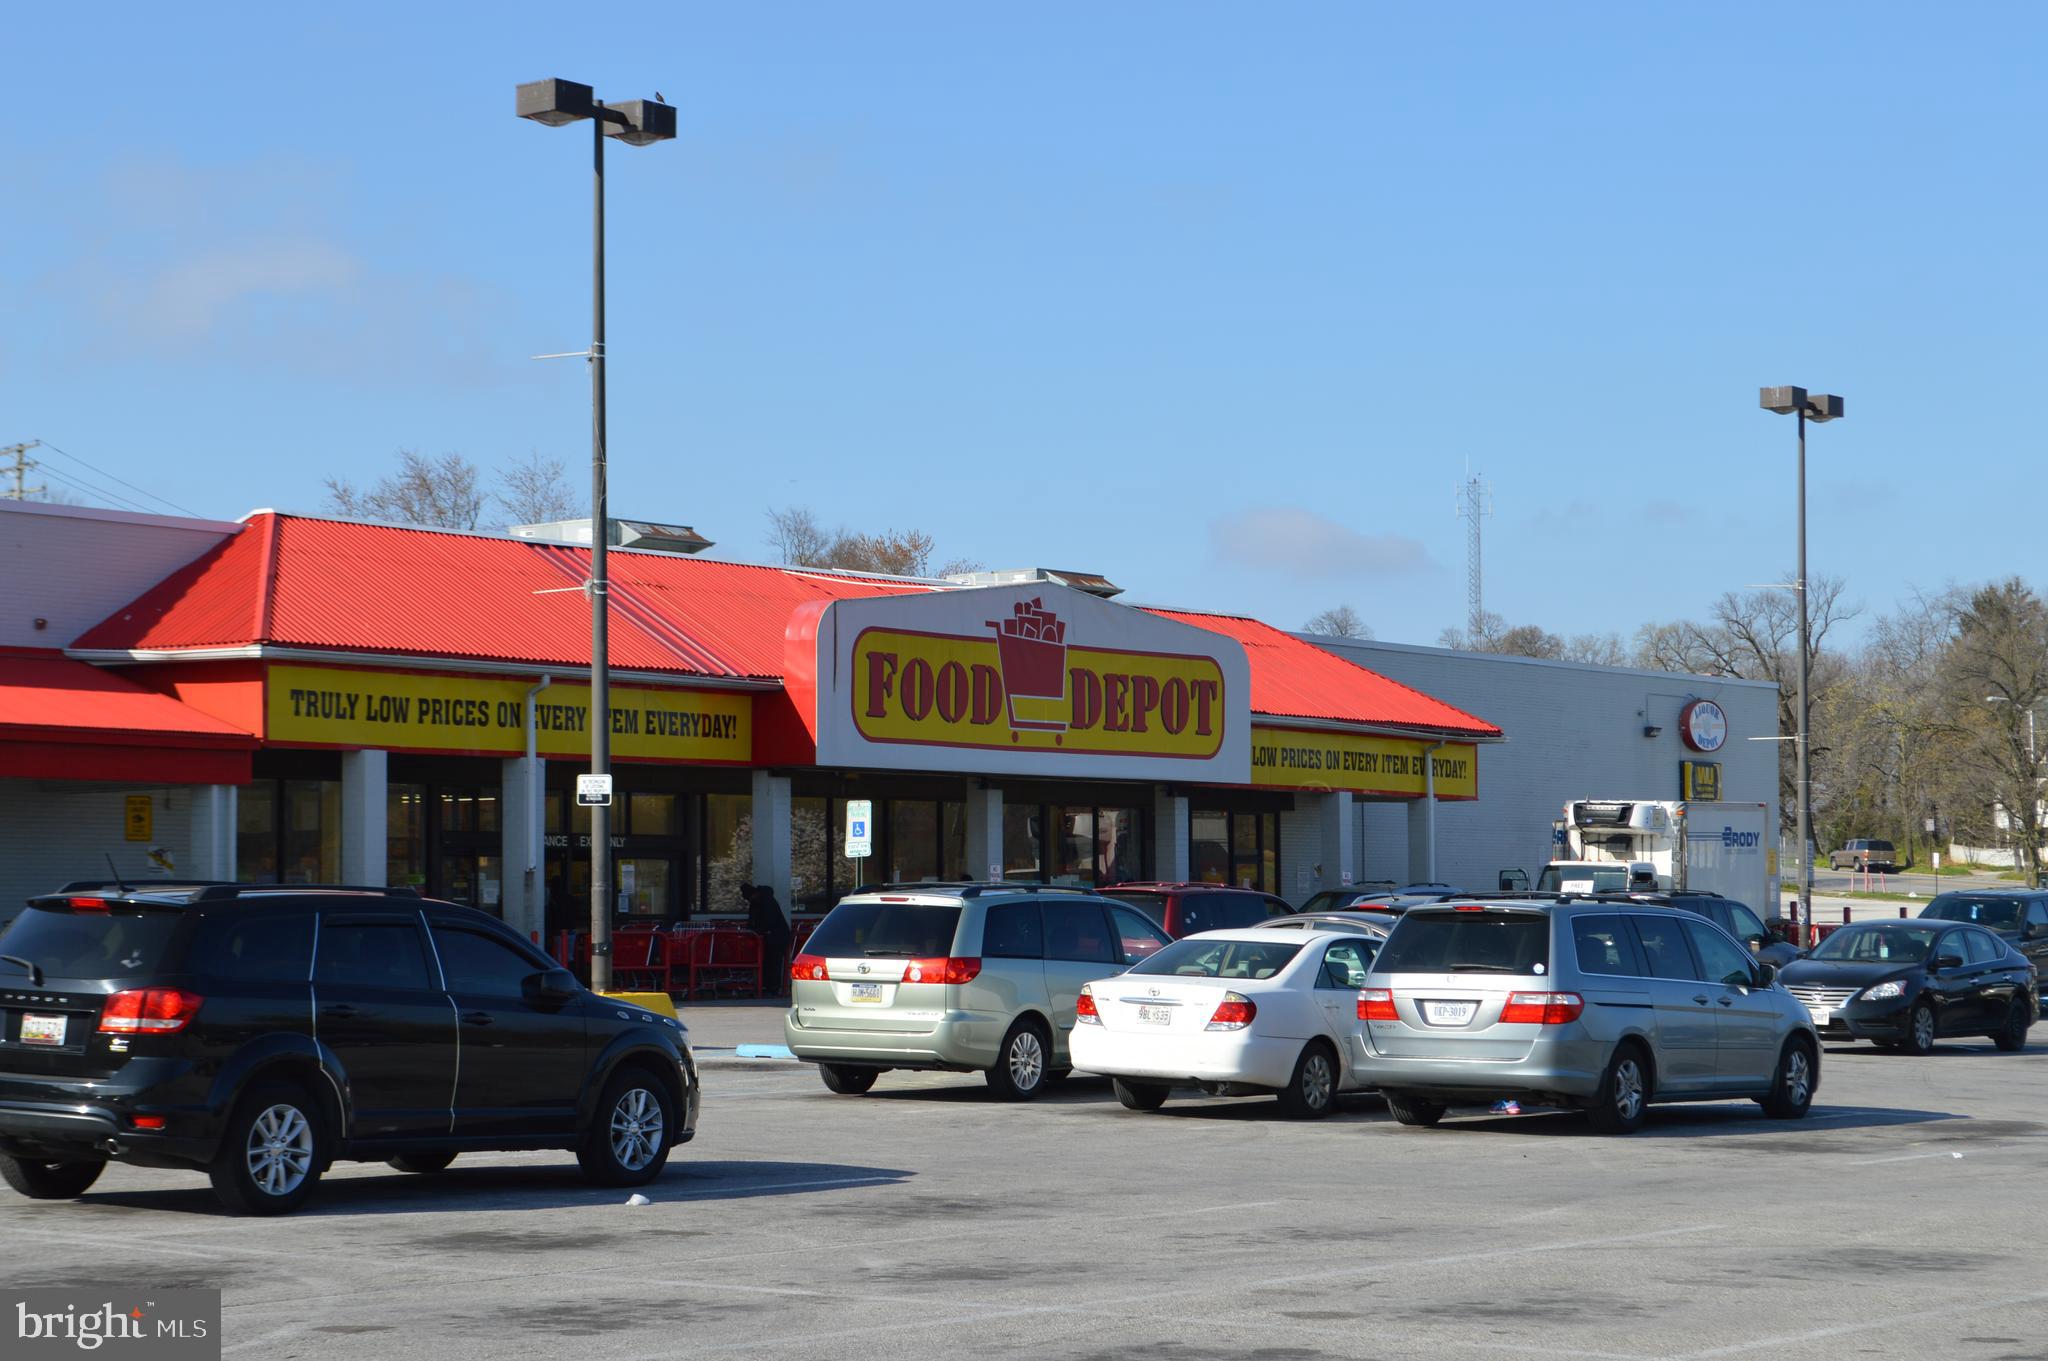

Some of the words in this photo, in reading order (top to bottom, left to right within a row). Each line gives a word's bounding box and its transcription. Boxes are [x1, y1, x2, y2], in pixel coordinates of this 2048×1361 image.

[866, 651, 1003, 725] FOOD
[1069, 668, 1218, 736] DEPOT
[290, 689, 359, 720] TRULY
[366, 695, 410, 724] LOW
[418, 698, 490, 727] PRICES
[497, 702, 521, 728] ON
[608, 708, 639, 735] EM
[645, 710, 737, 739] EVERYDAY!
[1252, 746, 1277, 767] LOW
[1281, 748, 1322, 770] PRICES
[1326, 751, 1341, 770] ON
[1343, 752, 1379, 773] EVERY
[1381, 754, 1409, 775] ITEM
[1412, 756, 1467, 779] EVRYDAY!
[609, 837, 625, 848] NLY
[1721, 826, 1760, 847] BRODY
